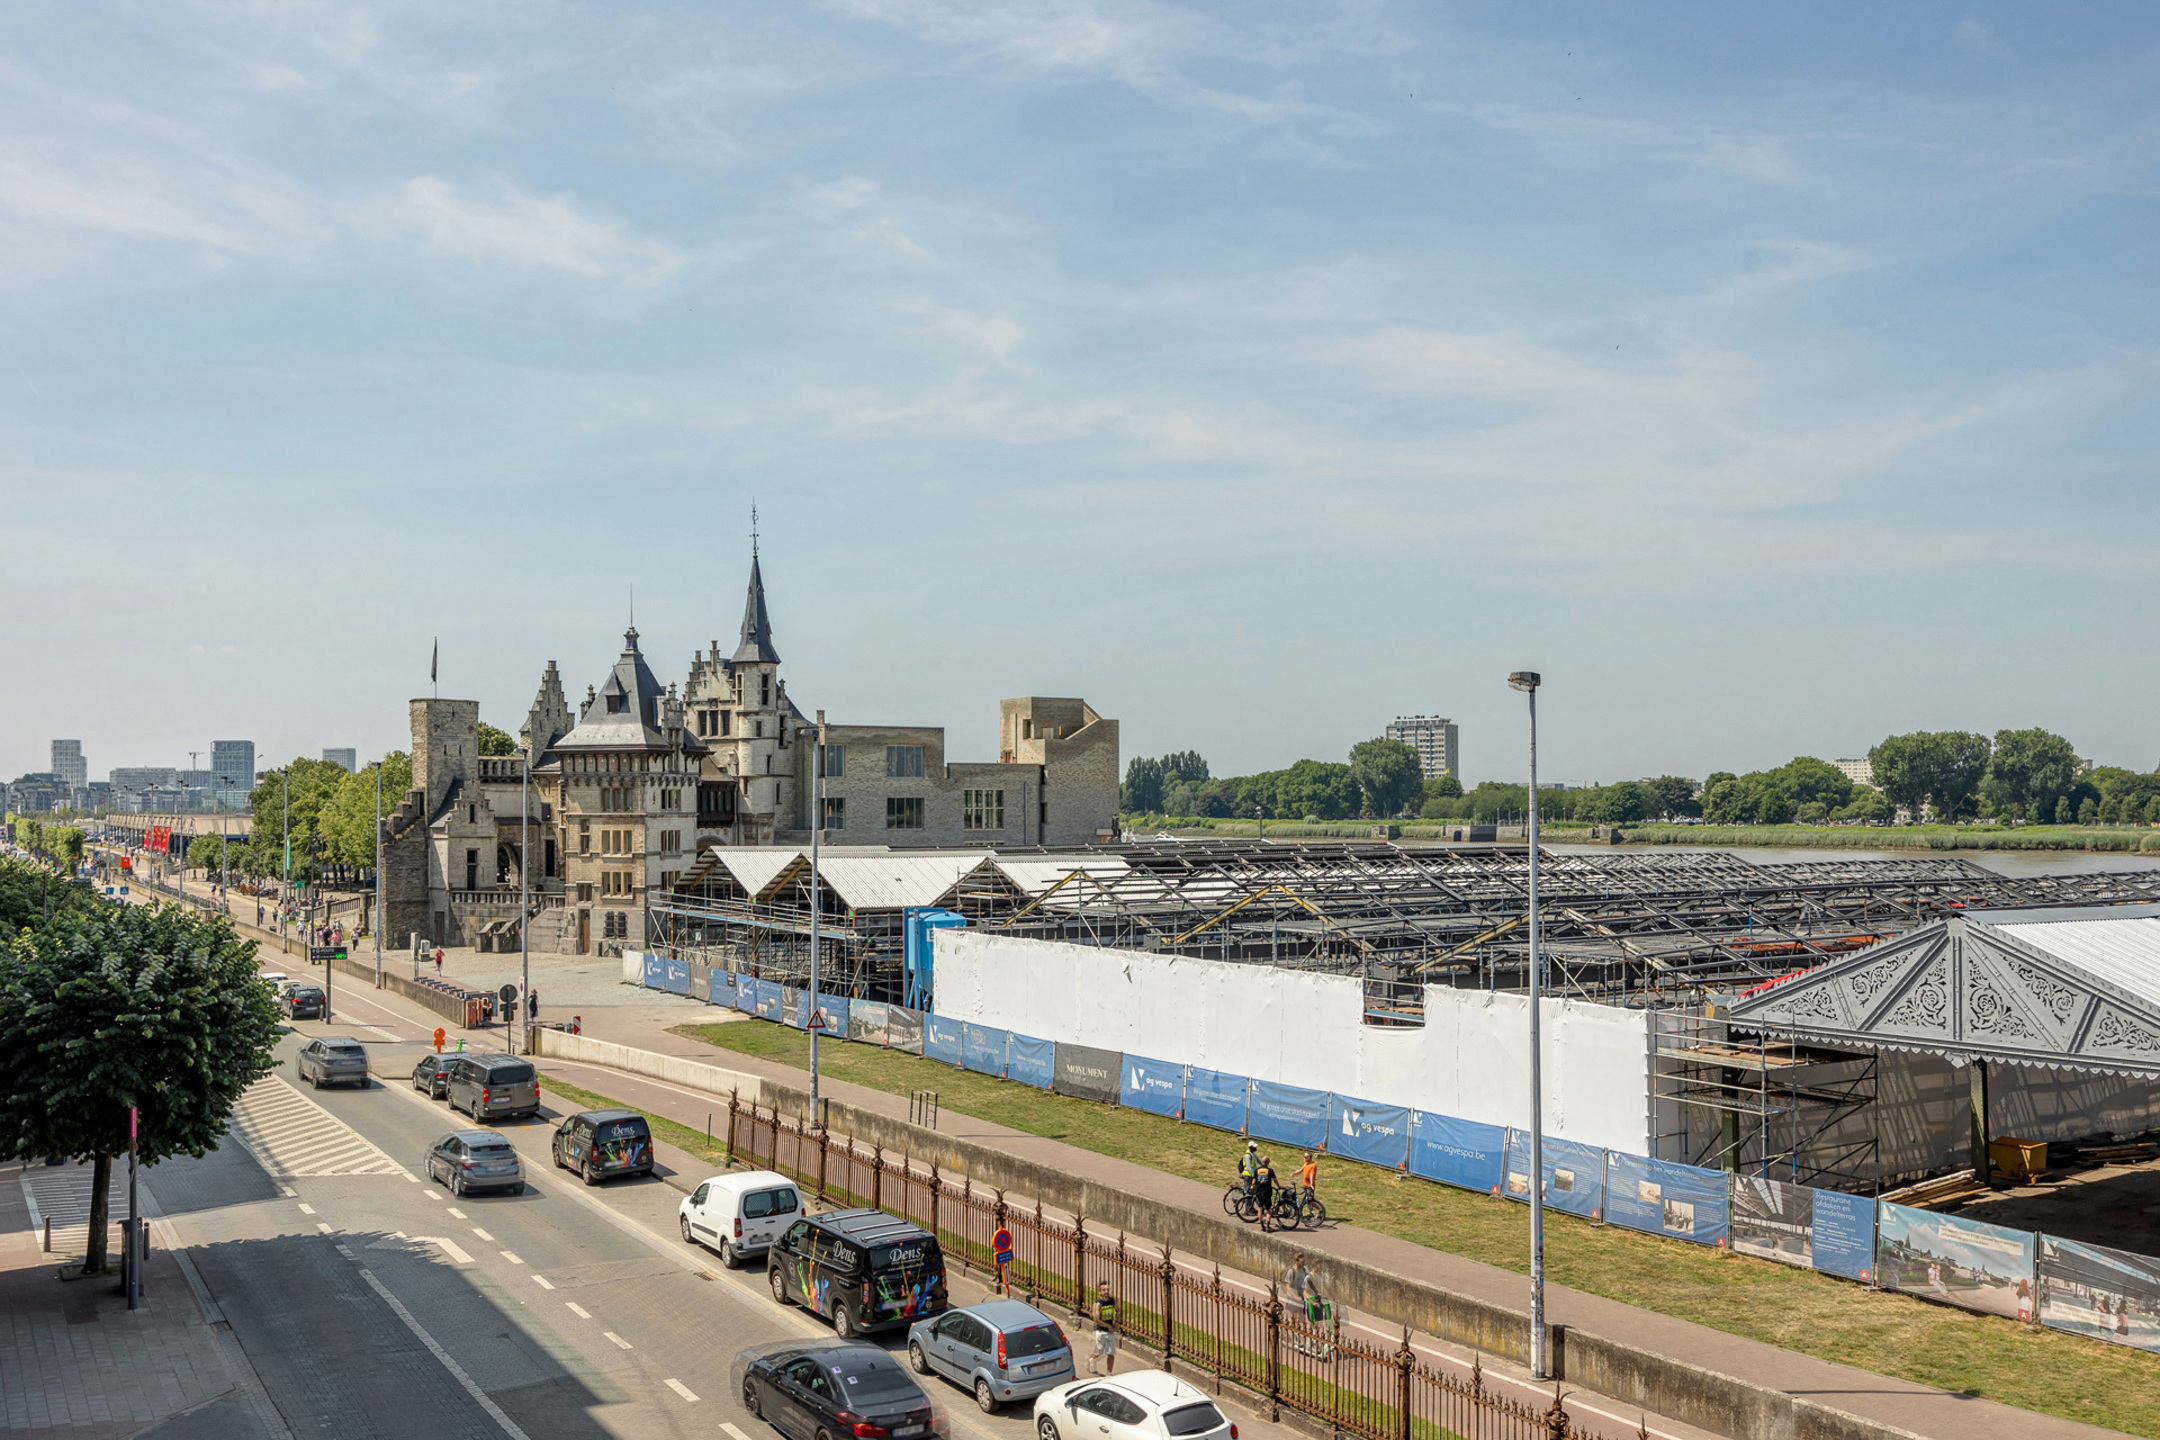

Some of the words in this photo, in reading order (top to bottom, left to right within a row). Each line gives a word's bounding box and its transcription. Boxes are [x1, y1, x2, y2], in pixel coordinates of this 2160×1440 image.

[1066, 1064, 1108, 1079] MONUMENT
[1146, 1078, 1154, 1087] ag
[1155, 1079, 1173, 1090] vespa
[611, 1126, 634, 1136] Dens
[1361, 1122, 1371, 1133] ag
[1373, 1124, 1395, 1137] vespa
[1427, 1141, 1486, 1160] www.agvespa.be
[1816, 1191, 1852, 1206] Restauratie
[1815, 1208, 1856, 1221] wandelterras
[1816, 1201, 1842, 1211] afdaken
[1842, 1205, 1851, 1213] en
[833, 1240, 857, 1264] Dens
[889, 1246, 922, 1263] Dens
